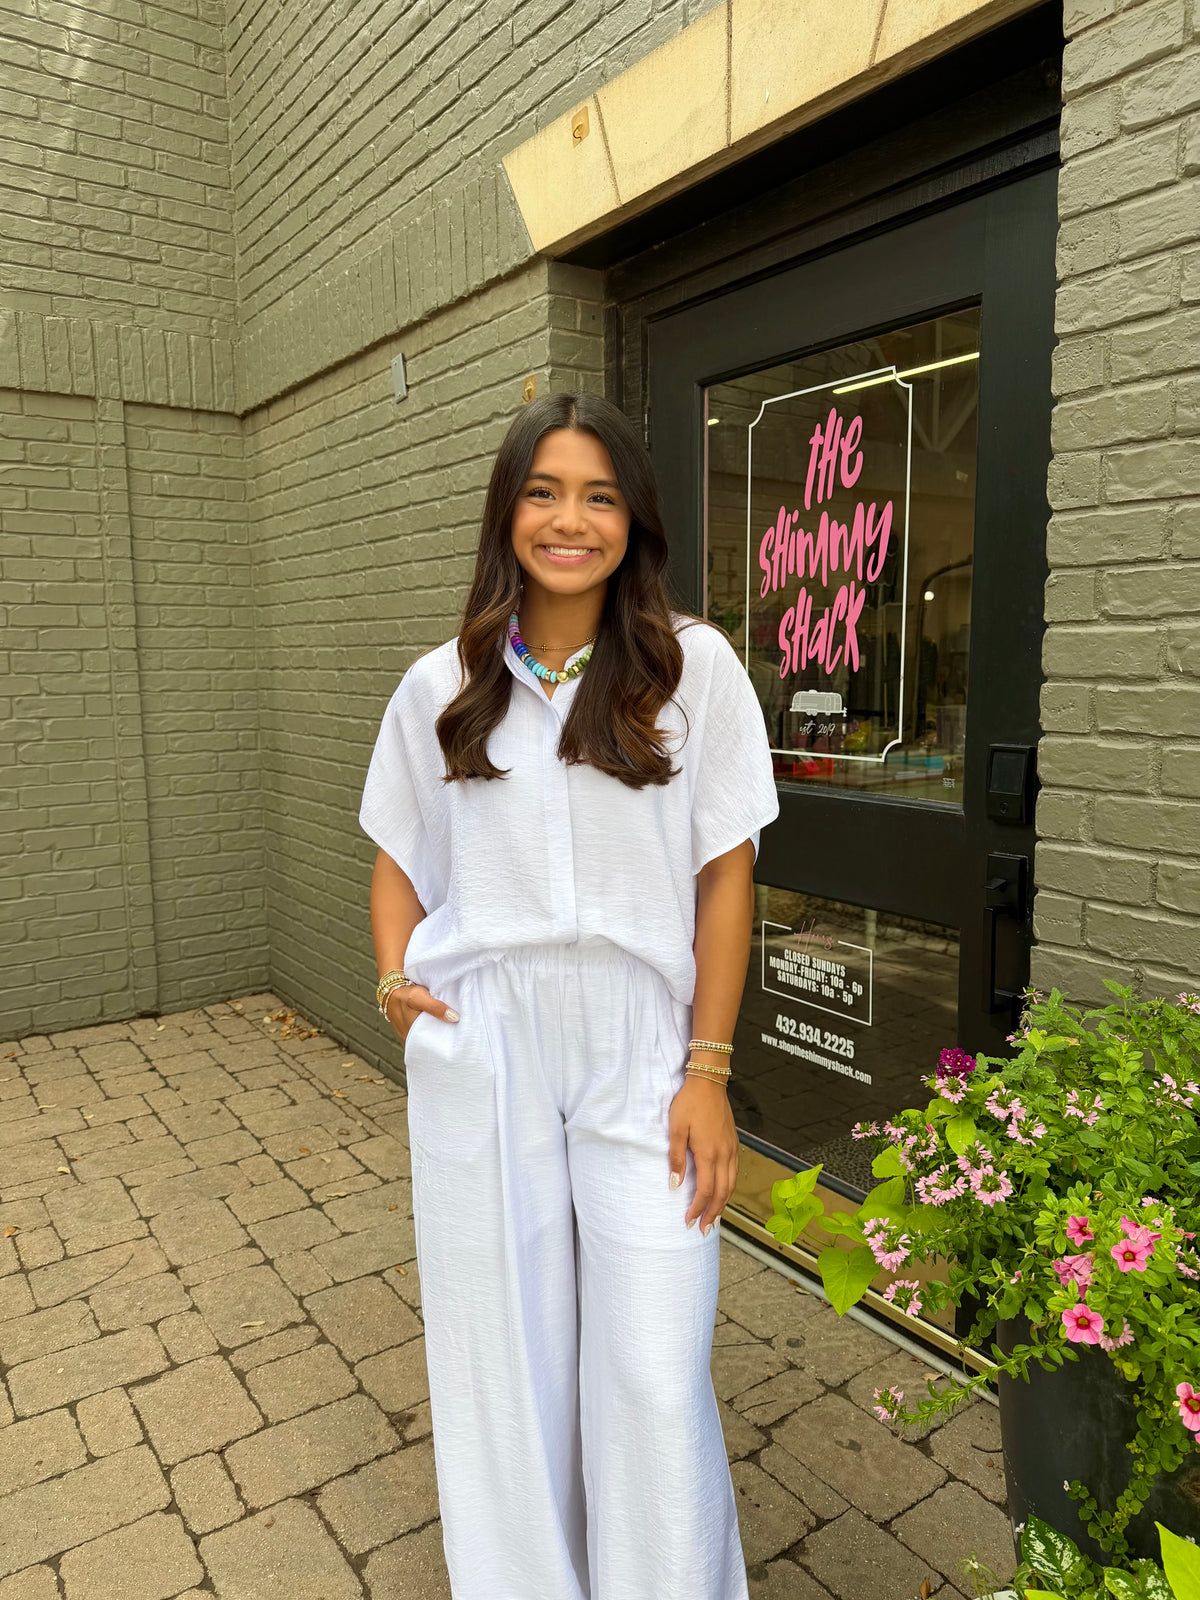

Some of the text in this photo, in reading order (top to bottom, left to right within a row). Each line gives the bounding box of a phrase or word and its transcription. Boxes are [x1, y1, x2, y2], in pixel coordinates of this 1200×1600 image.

[784, 949, 846, 977] CLOSED SUNDAYS
[777, 970, 819, 993] SATURDAYS:
[821, 984, 835, 999] 10a
[842, 990, 854, 1006] 5p
[830, 975, 844, 989] 10a
[852, 981, 863, 996] 6p
[775, 1013, 855, 1059] 432.934.2225
[761, 1033, 872, 1085] www.shoptheshimmyshack.com
